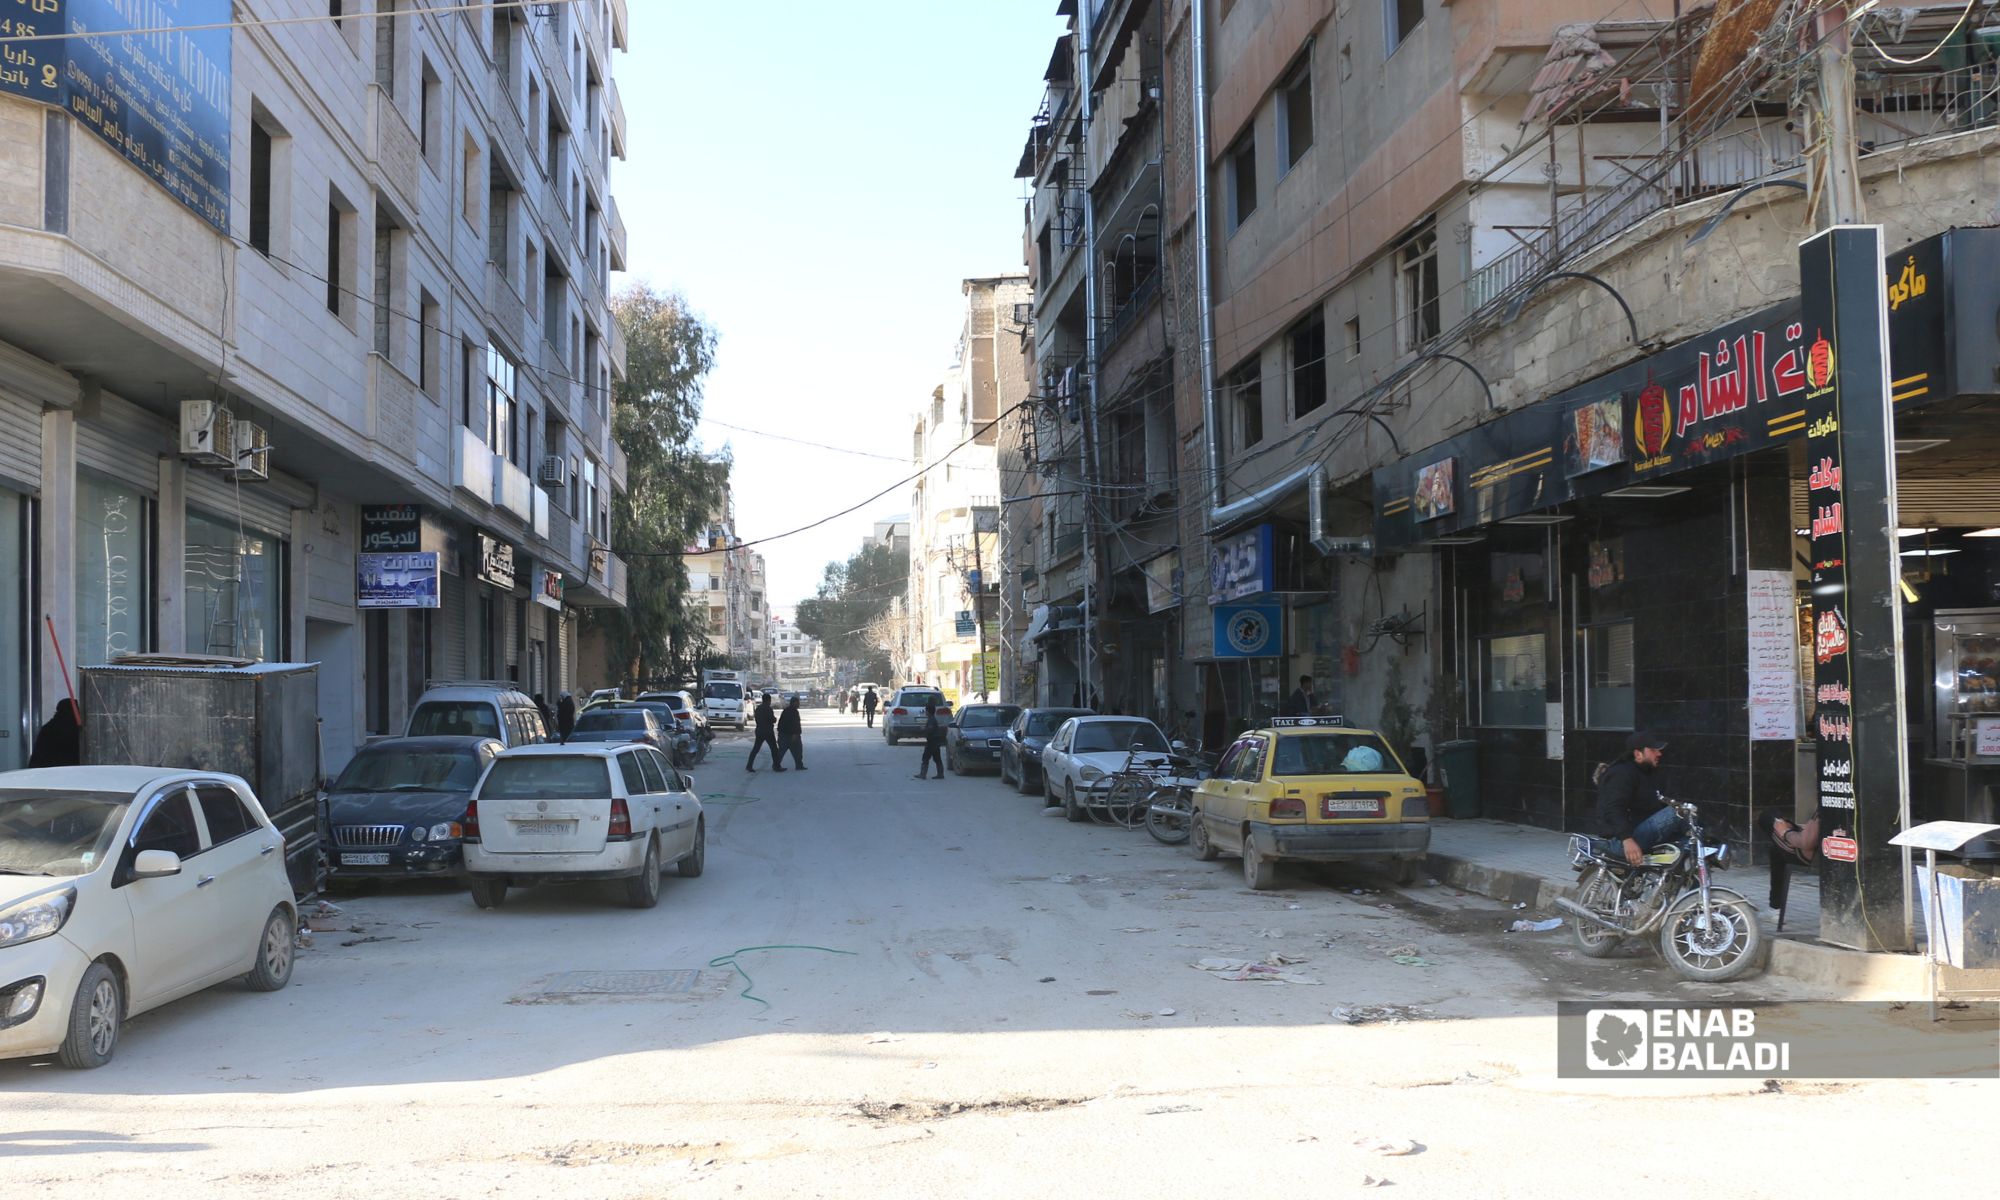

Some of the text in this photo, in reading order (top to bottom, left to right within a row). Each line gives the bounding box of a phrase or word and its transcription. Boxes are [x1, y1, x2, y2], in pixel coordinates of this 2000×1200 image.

[16, 22, 36, 37] 85
[4, 44, 36, 66] داريا
[179, 31, 231, 120] MEDIZIN
[72, 94, 102, 126] العباس
[104, 121, 124, 144] جامع
[125, 134, 147, 166] باتجاه
[181, 181, 199, 204] ساحة
[204, 195, 219, 220] داريا
[1886, 255, 1927, 311] مأكو
[1677, 329, 1768, 438] الشام
[1808, 411, 1838, 439] مأكولات
[1809, 456, 1842, 491] بركات
[364, 505, 417, 525] شعيب
[1811, 502, 1843, 541] الشام
[364, 531, 417, 548] للديكور
[381, 554, 434, 574] ستارنت
